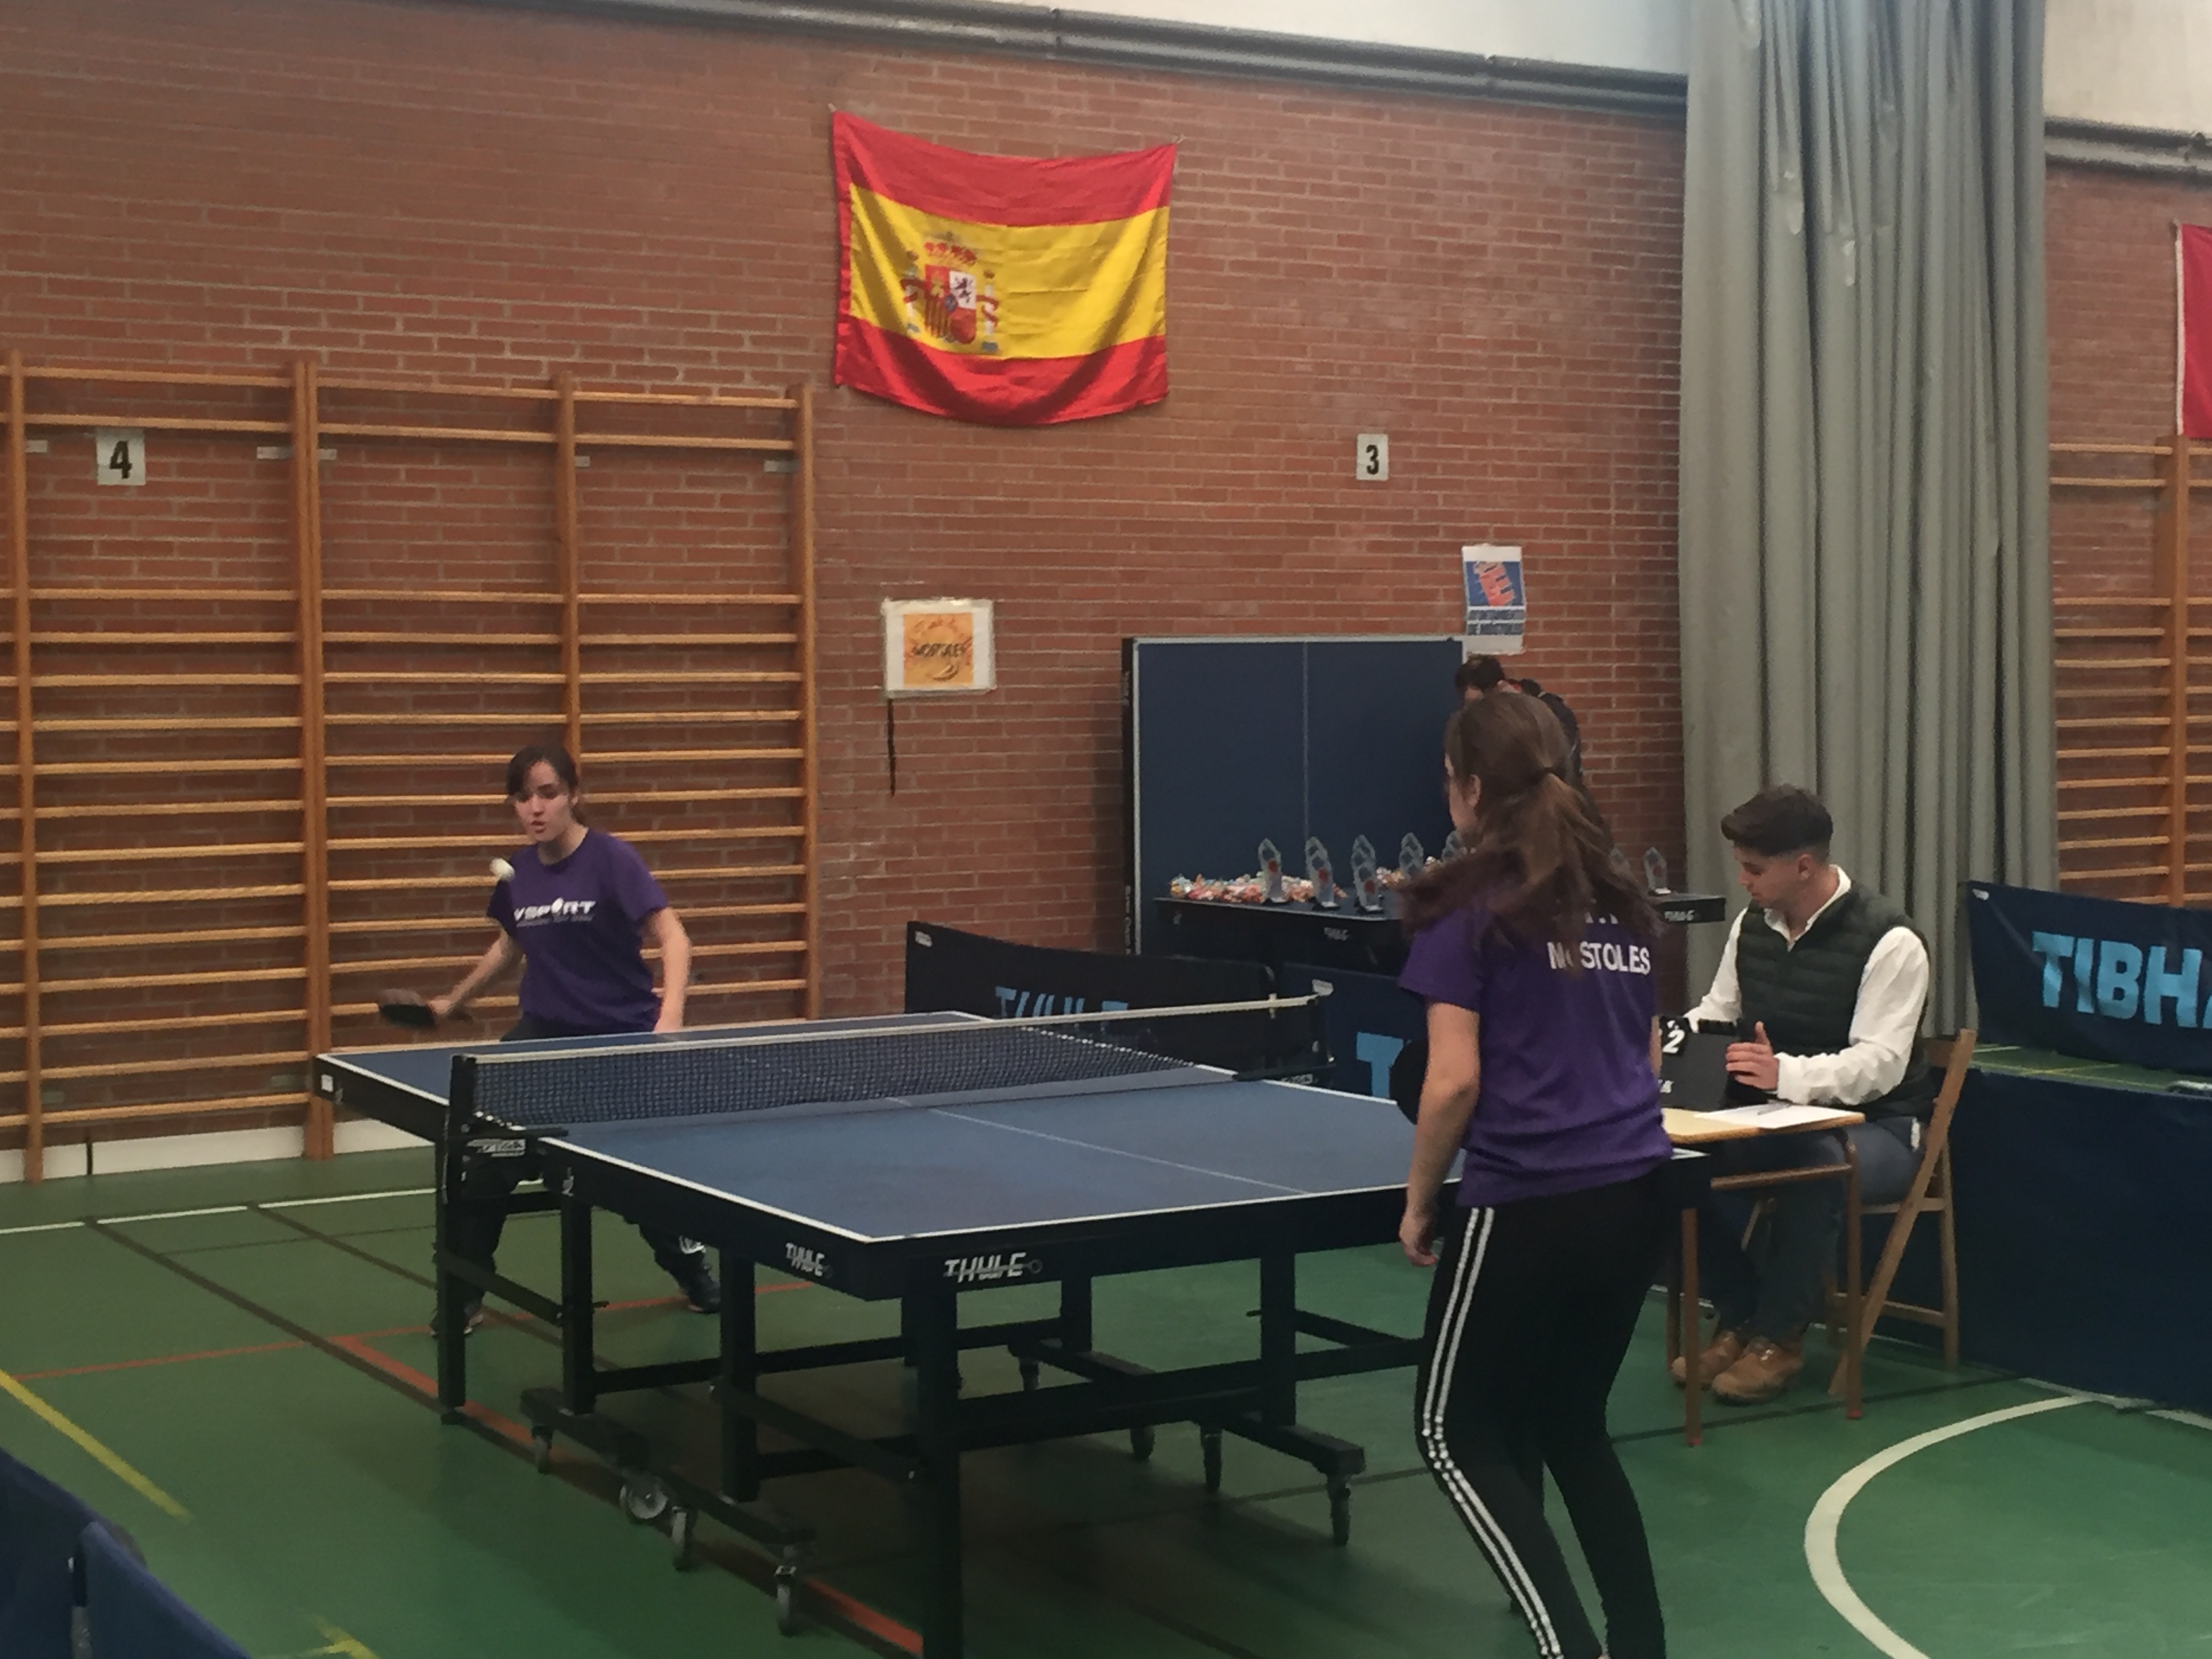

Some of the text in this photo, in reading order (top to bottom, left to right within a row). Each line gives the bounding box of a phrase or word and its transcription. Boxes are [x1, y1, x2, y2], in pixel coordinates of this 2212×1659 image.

[109, 441, 132, 478] 4
[1366, 444, 1379, 475] 3
[785, 1242, 825, 1277] THULE
[944, 1252, 1027, 1284] THULE
